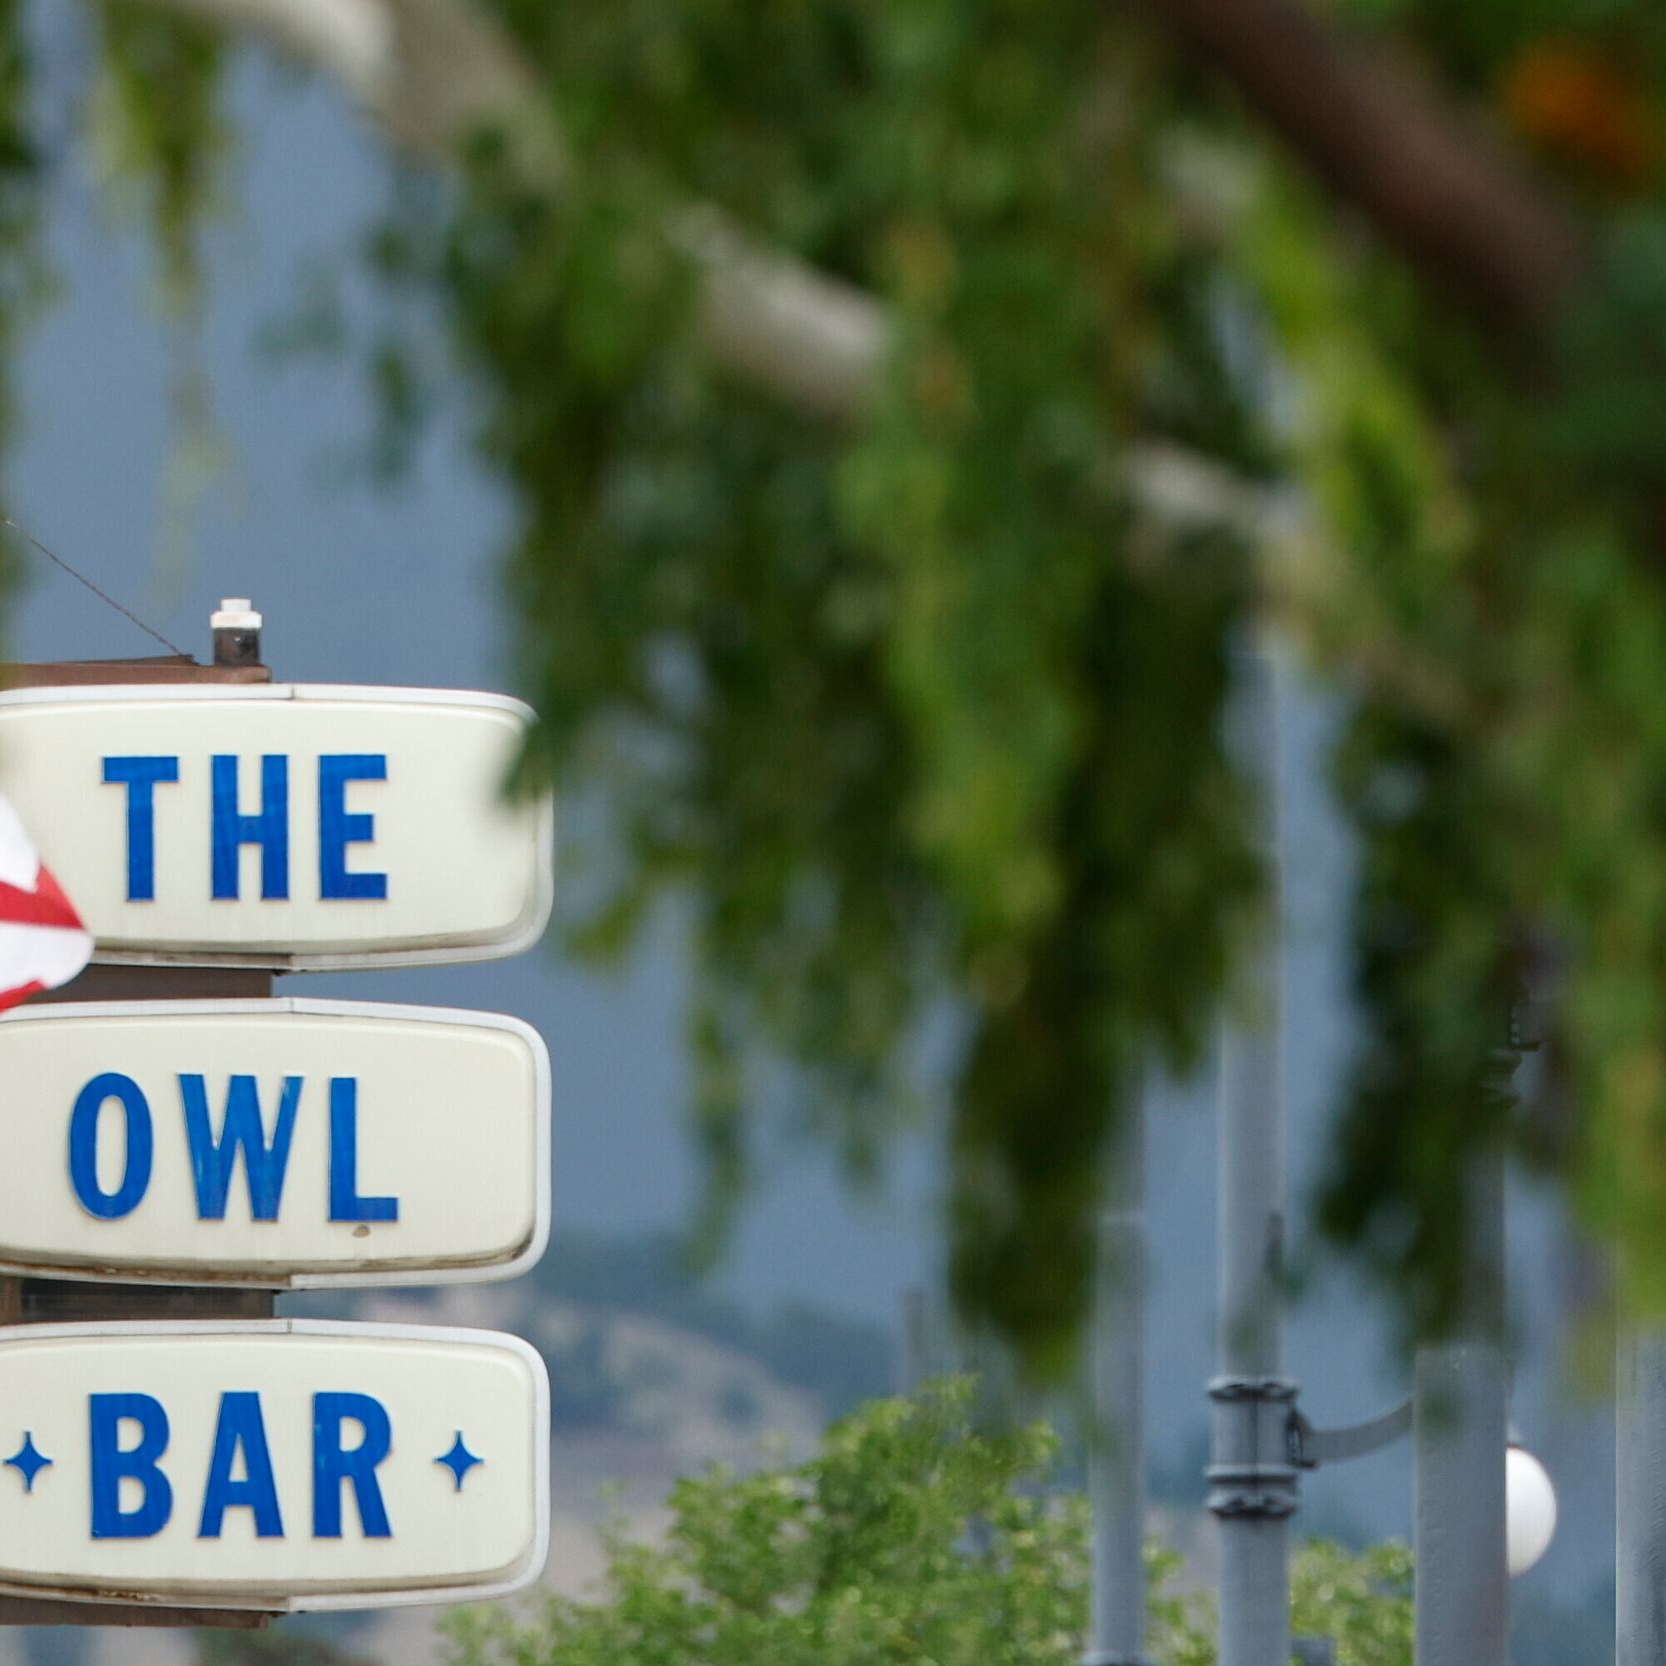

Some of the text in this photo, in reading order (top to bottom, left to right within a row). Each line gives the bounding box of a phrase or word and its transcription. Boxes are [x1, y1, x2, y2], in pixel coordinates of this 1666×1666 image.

[101, 754, 388, 901] THE
[68, 1072, 399, 1223] OWL
[88, 1391, 393, 1539] BAR
